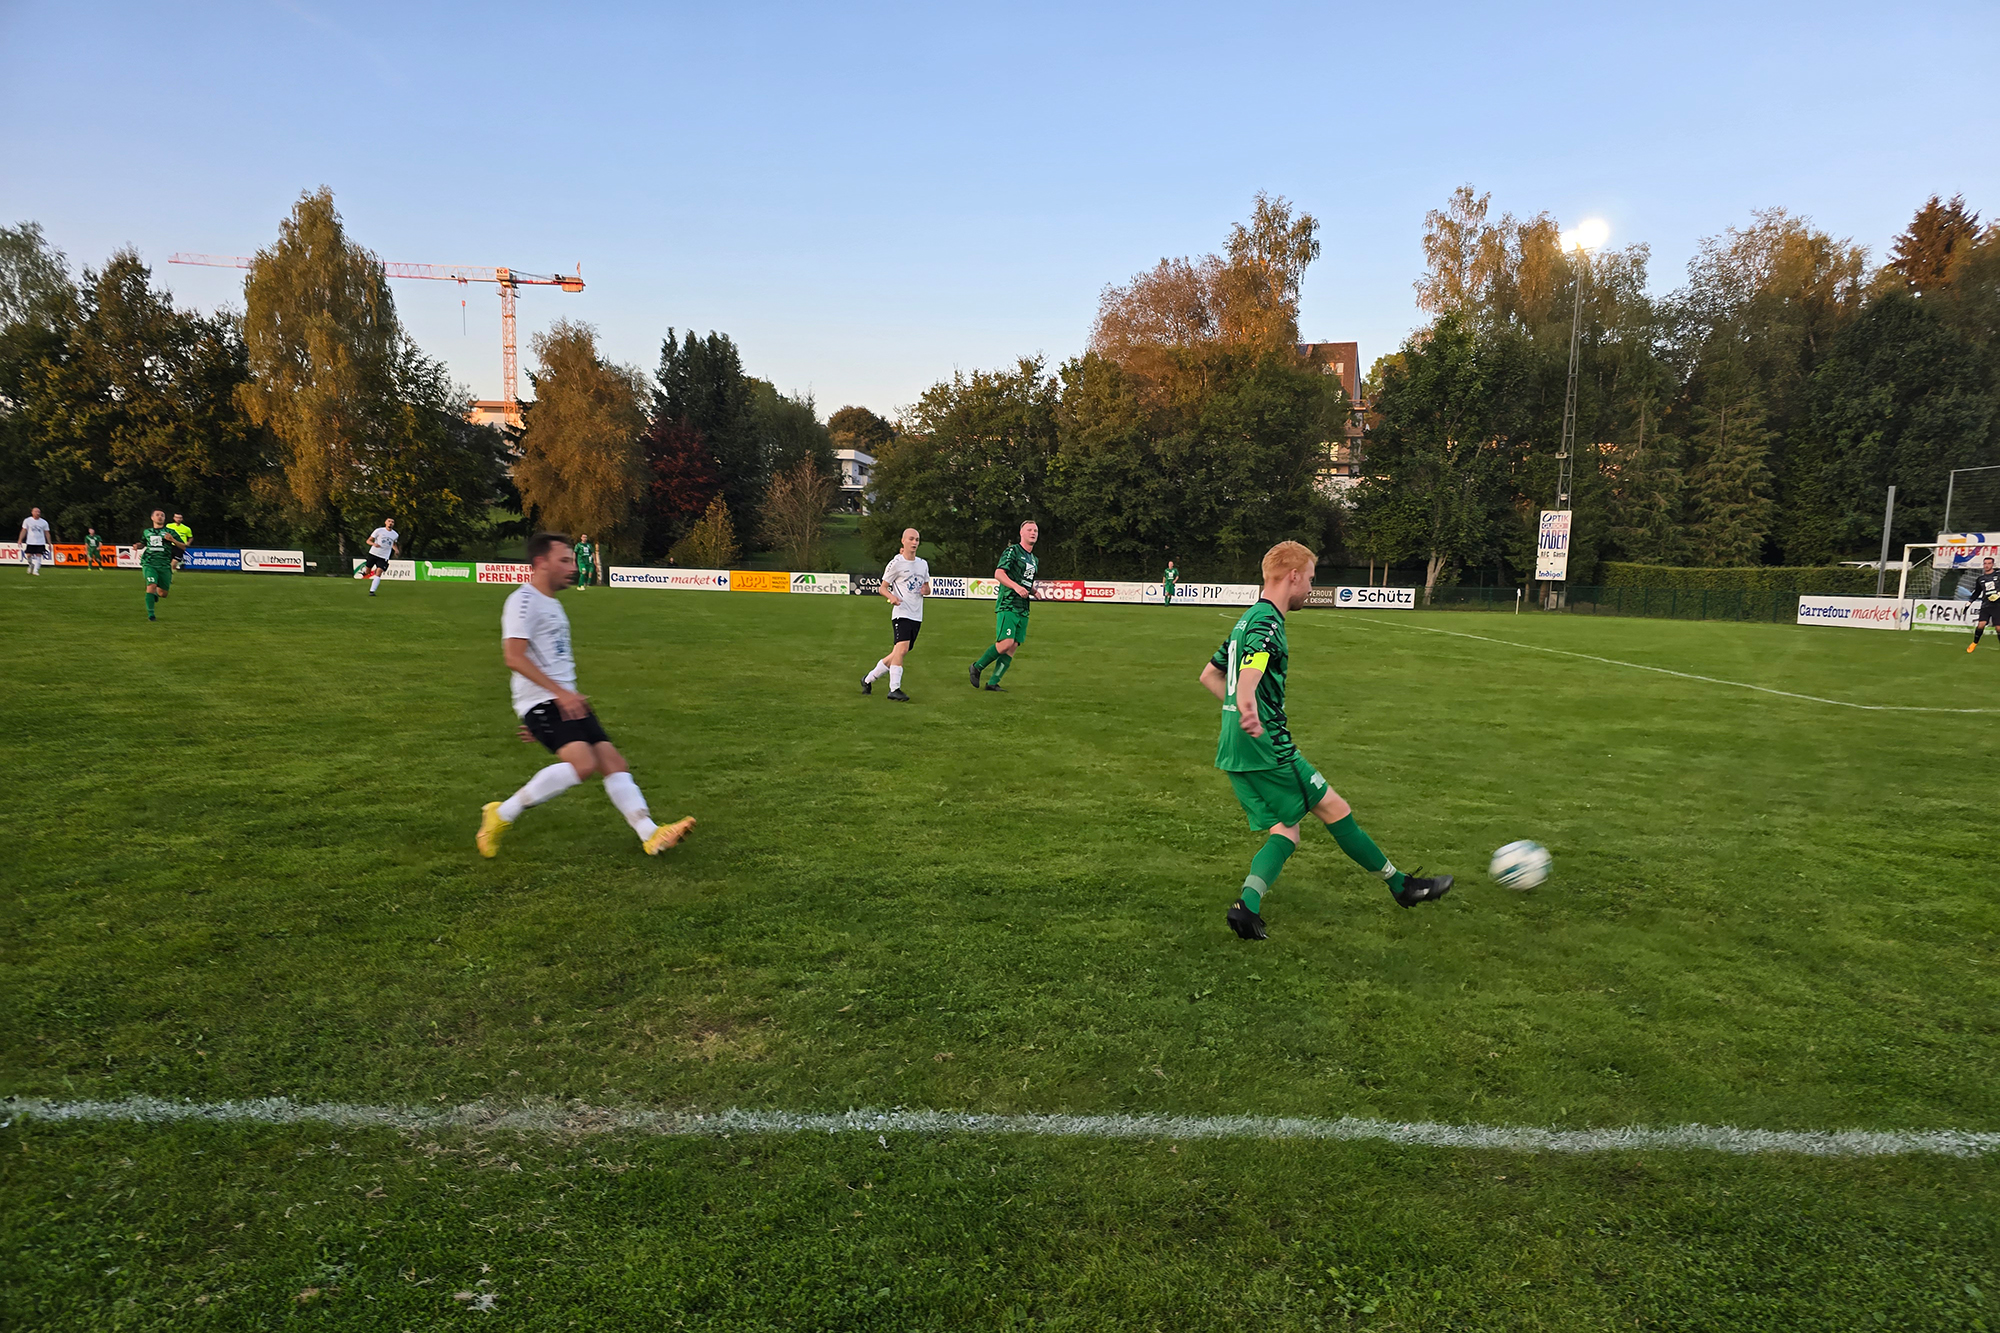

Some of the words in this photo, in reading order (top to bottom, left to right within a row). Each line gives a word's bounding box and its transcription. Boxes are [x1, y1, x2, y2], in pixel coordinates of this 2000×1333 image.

[1542, 513, 1569, 522] OPTIK
[1540, 530, 1567, 549] FABER
[610, 573, 669, 583] Carrefour
[671, 575, 710, 585] market
[933, 579, 965, 587] KRINGS-
[792, 584, 837, 592] mersch
[932, 588, 965, 596] MARAITE
[1202, 586, 1222, 598] PIP
[1358, 590, 1411, 603] Schütz
[1799, 604, 1850, 618] Carrefour
[1851, 606, 1891, 621] market
